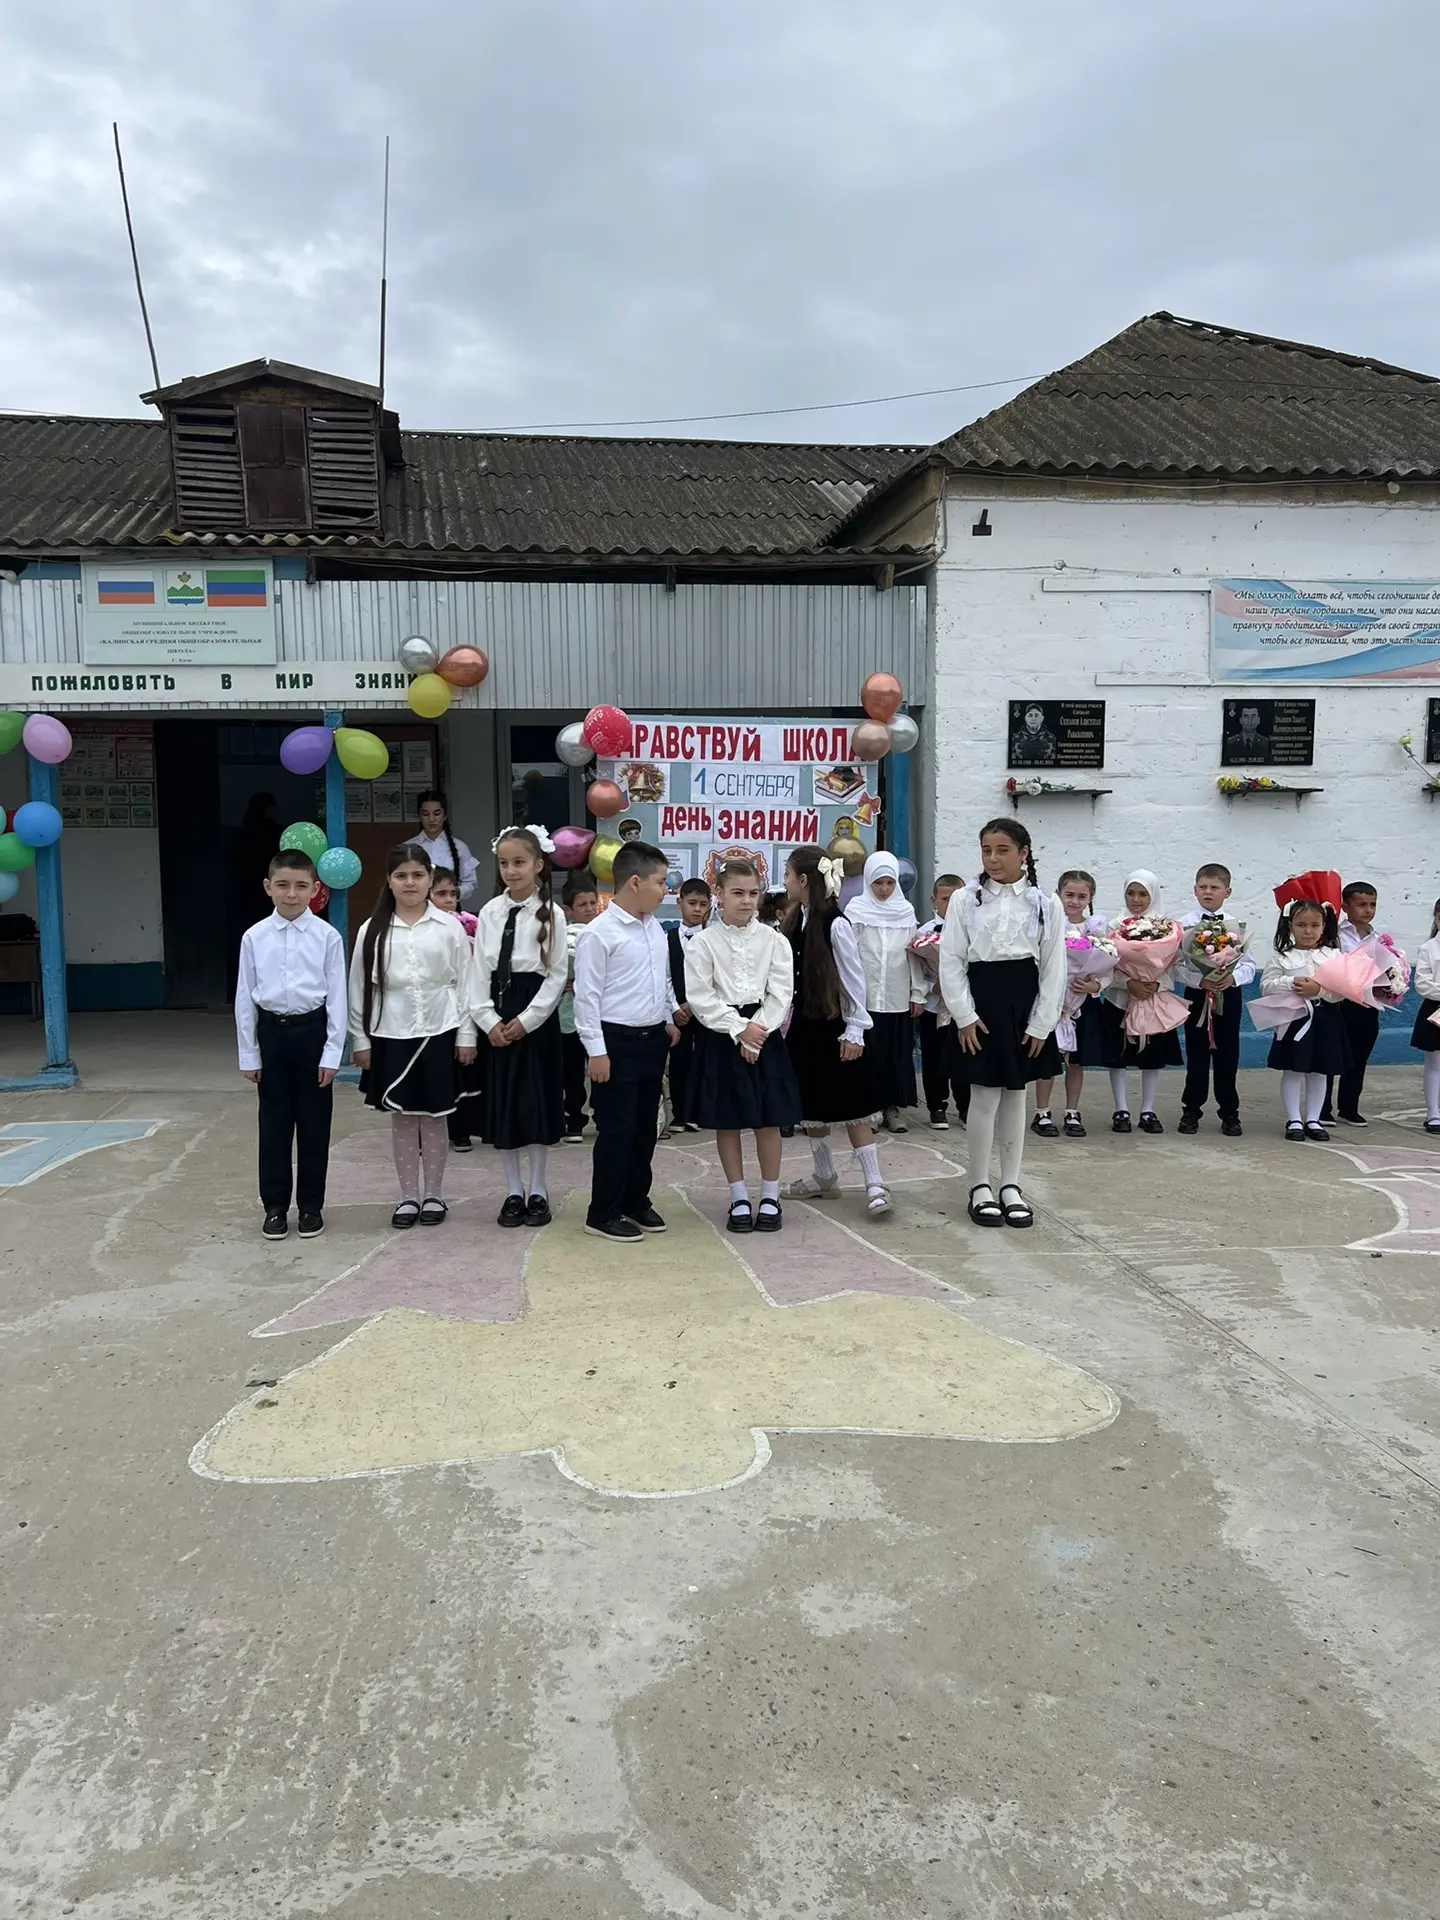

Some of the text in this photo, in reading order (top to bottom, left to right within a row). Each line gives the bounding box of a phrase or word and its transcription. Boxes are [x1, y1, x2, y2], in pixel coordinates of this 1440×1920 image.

[1257, 588, 1292, 601] должны
[1294, 588, 1328, 600] сделать
[1329, 591, 1344, 601] всё,
[1347, 589, 1375, 600] чтобы
[1377, 590, 1430, 600] сегодняшние
[1245, 607, 1268, 615] наши
[1270, 605, 1310, 617] граждане
[1312, 604, 1355, 617] гордились
[1380, 607, 1397, 615] что
[1398, 607, 1413, 615] они
[1232, 622, 1272, 632] правнуки
[1275, 619, 1330, 630] победителей.
[1333, 621, 1359, 630] Знали
[1361, 622, 1387, 632] героев
[1389, 620, 1410, 630] своей
[1259, 634, 1288, 645] чтобы
[1304, 637, 1349, 646] понимали,
[1389, 637, 1413, 645] часть
[31, 672, 418, 691] ПОЖАЛОВАТЬ В МИР ЗНАНИ
[617, 724, 762, 762] РАВСТВУЙ
[694, 767, 796, 798] 1 СЕНТЯБРЯ
